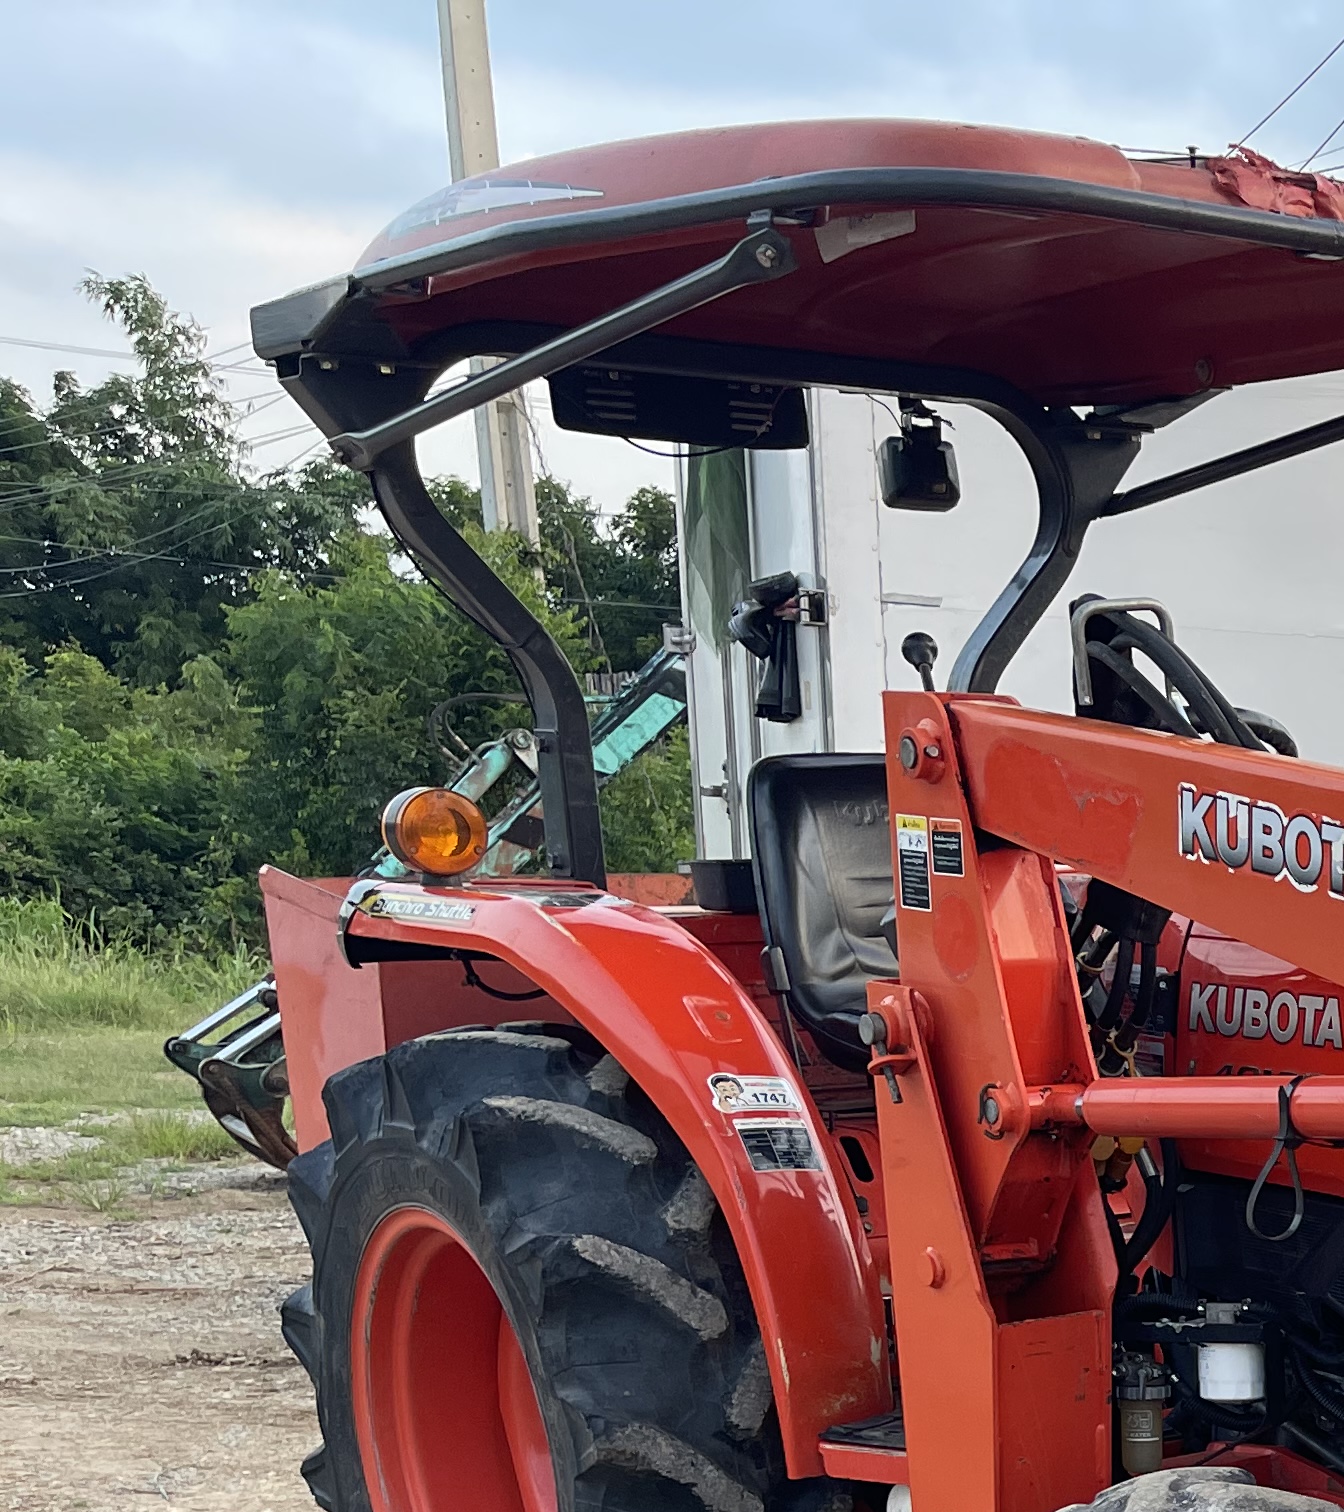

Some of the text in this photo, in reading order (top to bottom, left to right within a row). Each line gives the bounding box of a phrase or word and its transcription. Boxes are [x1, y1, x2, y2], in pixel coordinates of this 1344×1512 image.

[369, 898, 475, 920] Synchro Shuttle
[1188, 982, 1344, 1050] KUBOTA
[751, 1092, 787, 1104] 1747
